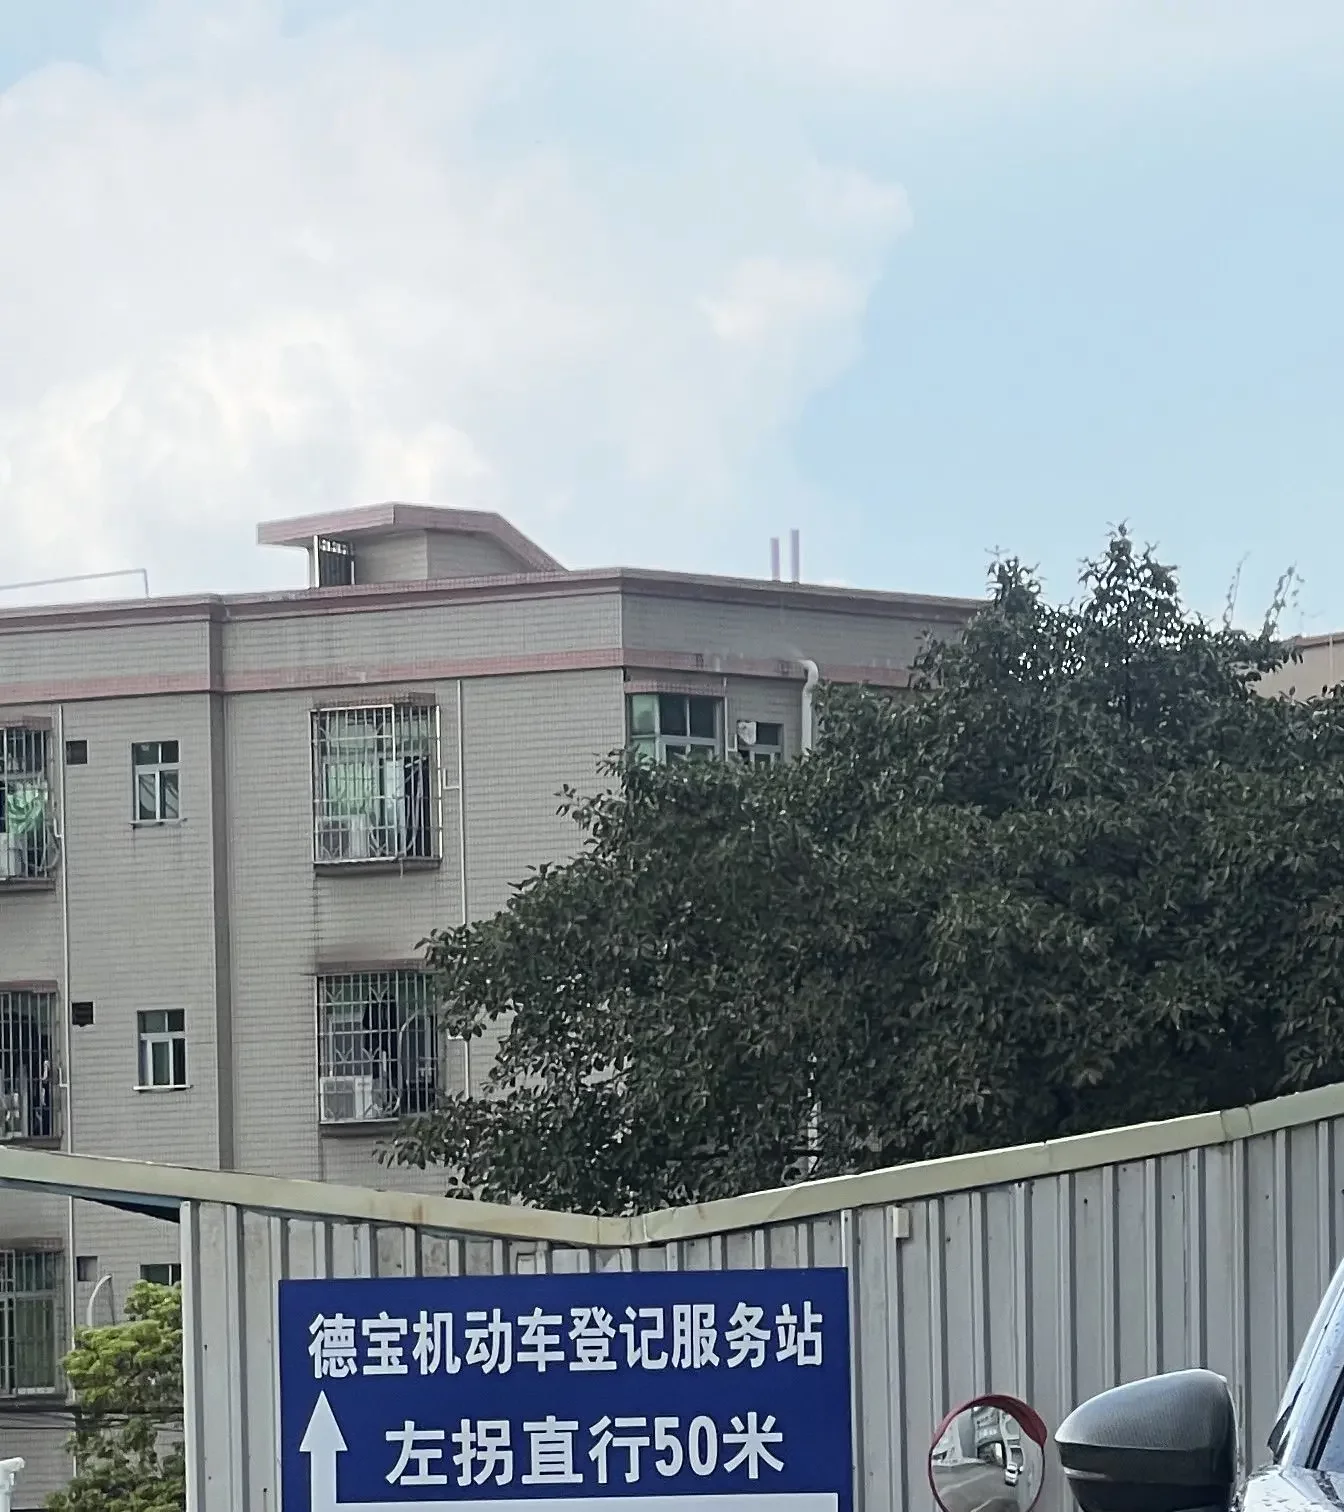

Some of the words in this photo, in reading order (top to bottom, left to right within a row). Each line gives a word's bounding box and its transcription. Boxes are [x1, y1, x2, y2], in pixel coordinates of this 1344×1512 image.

[308, 1300, 823, 1379] 德宝机动车登记服务站
[384, 1411, 785, 1487] 左拐直行50米
